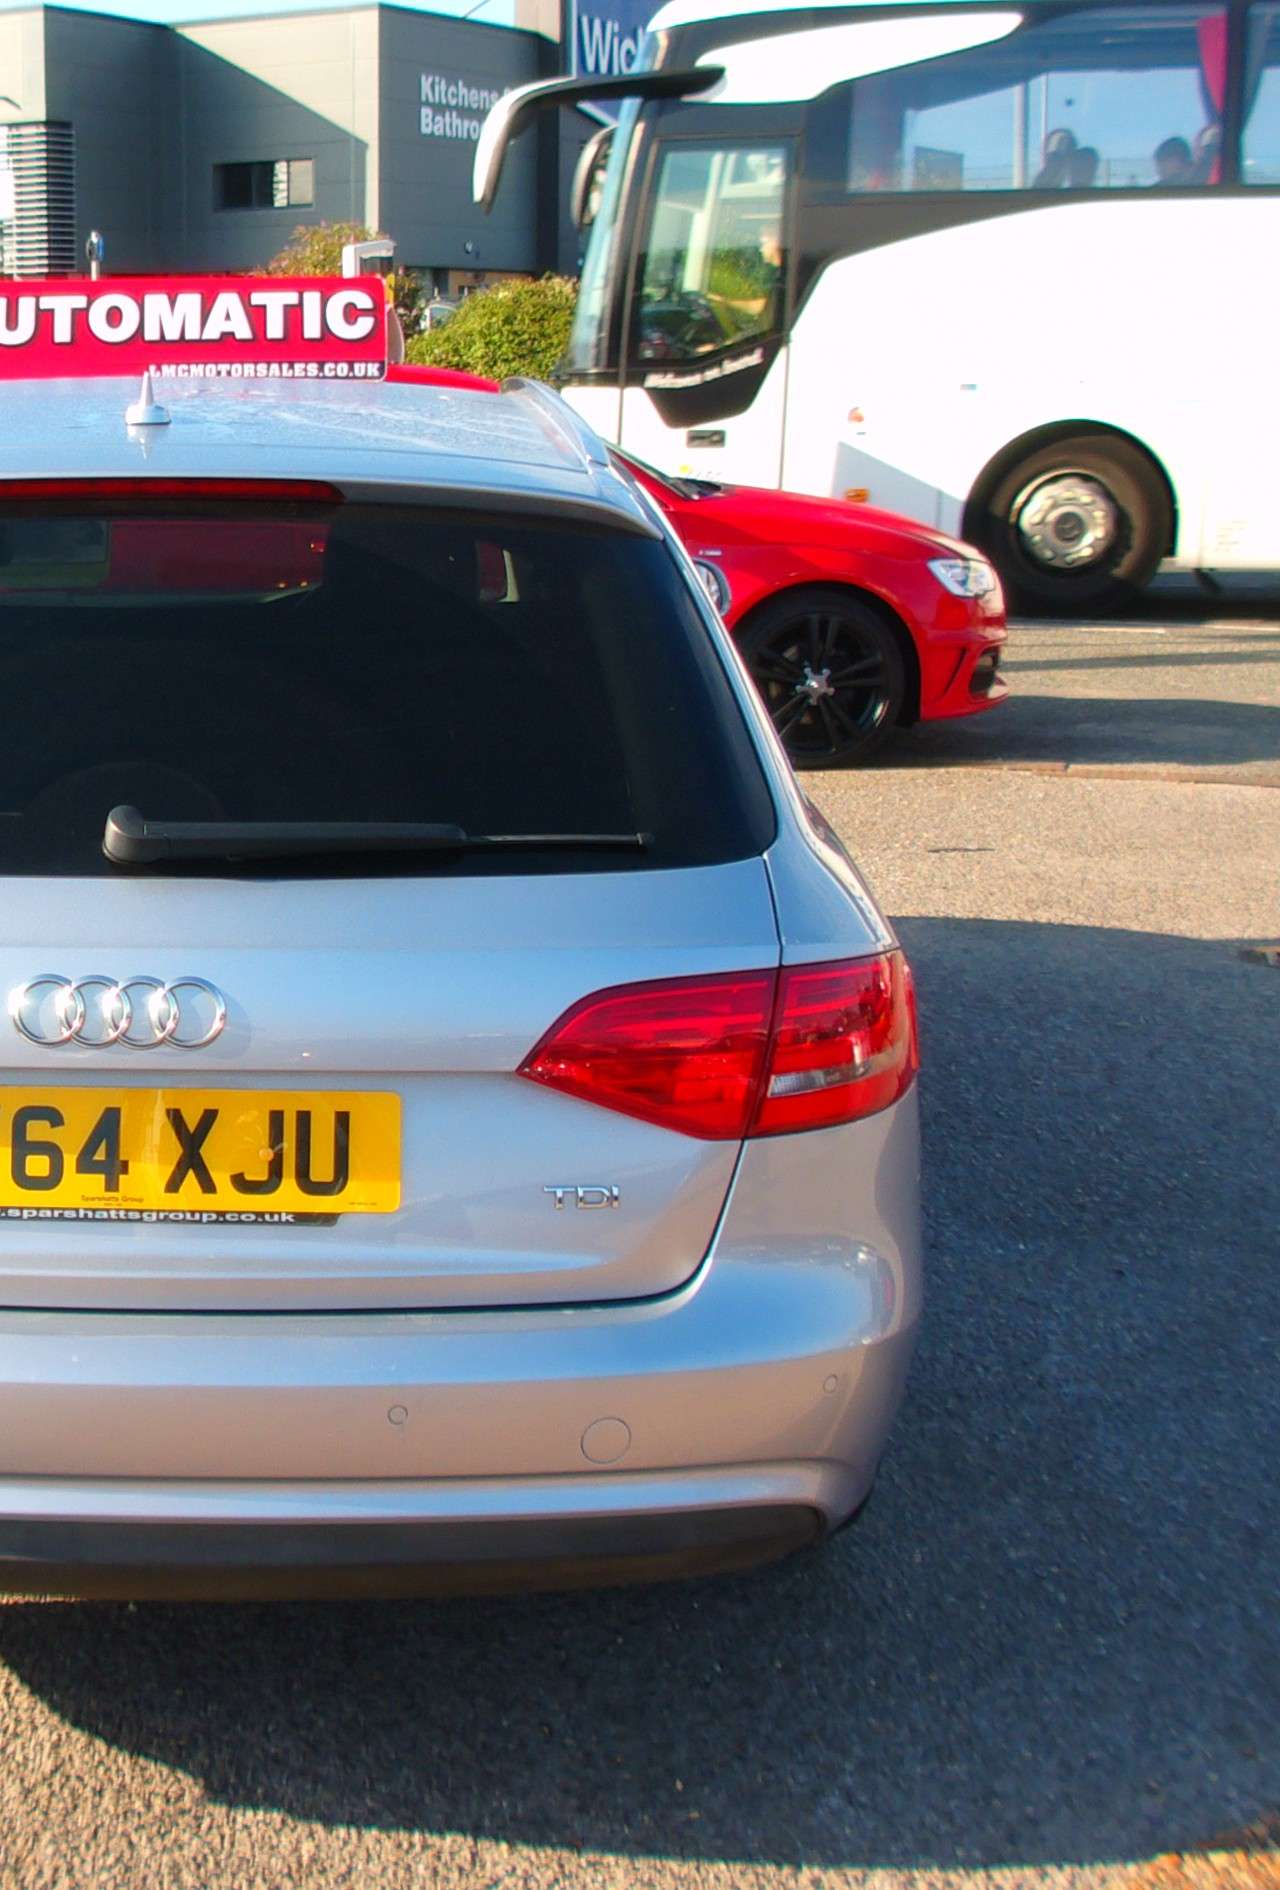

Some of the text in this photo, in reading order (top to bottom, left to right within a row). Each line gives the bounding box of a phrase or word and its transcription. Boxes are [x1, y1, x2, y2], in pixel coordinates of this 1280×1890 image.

[420, 104, 481, 139] Bathro
[148, 362, 381, 378] LMCMOTORSALES.CO.UK
[164, 1108, 350, 1196] XJU
[543, 1184, 620, 1210] TDI
